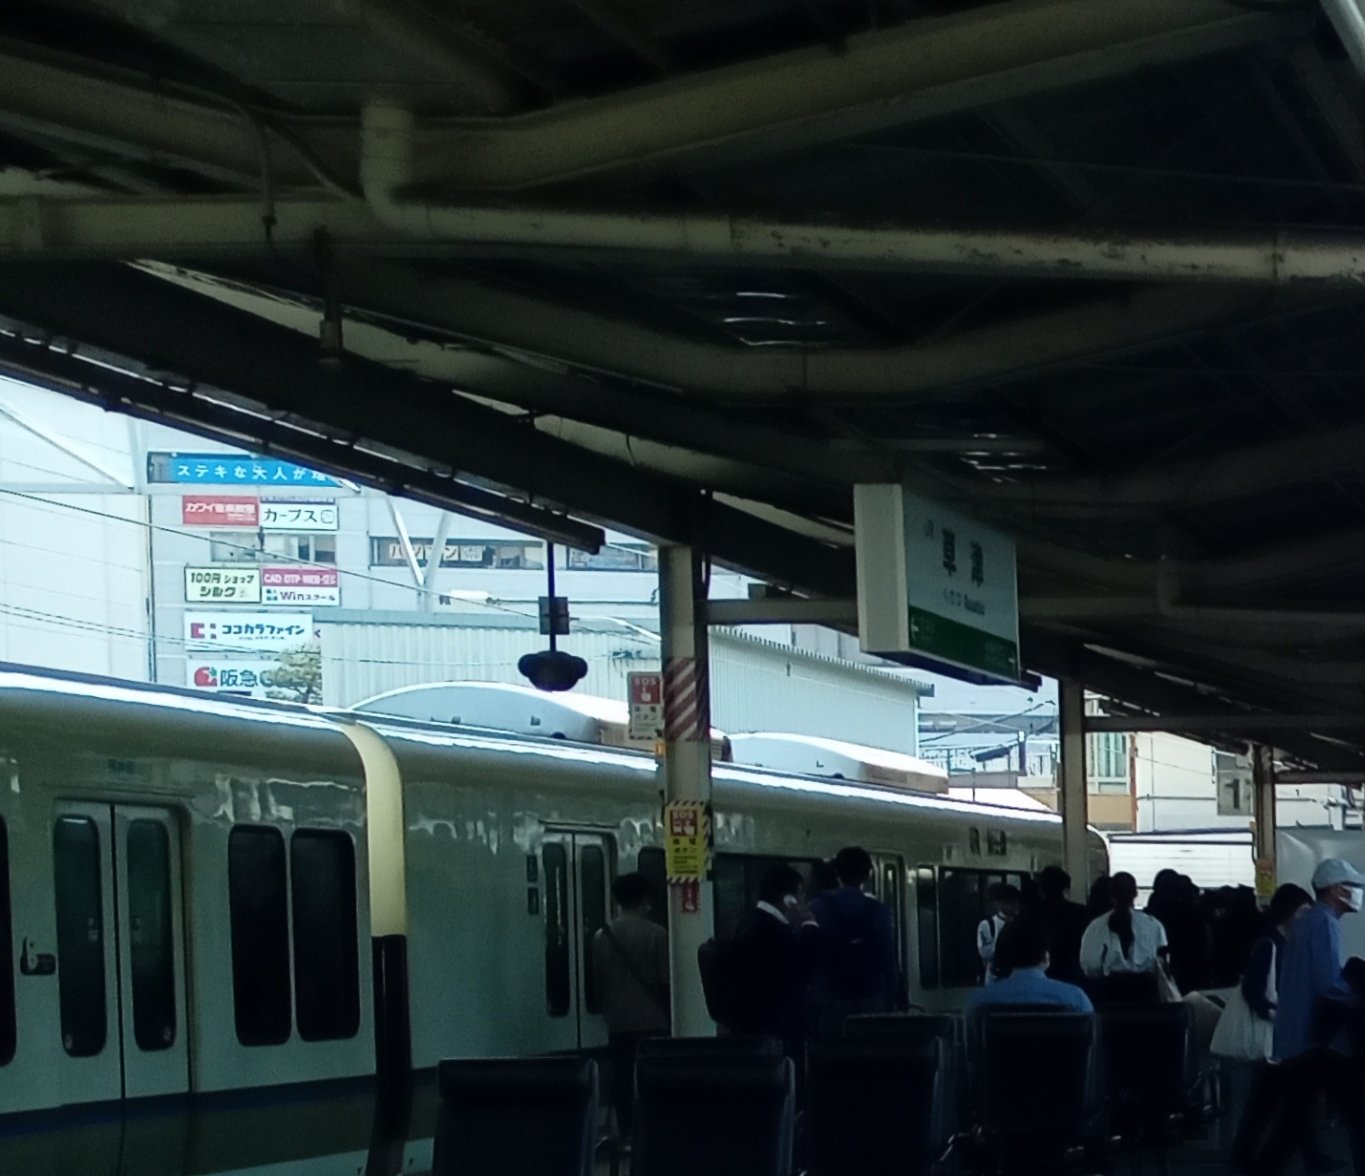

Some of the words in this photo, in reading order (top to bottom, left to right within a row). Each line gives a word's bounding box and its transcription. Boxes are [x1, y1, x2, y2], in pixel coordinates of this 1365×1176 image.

[221, 623, 305, 636] ココカラファイン
[1225, 778, 1240, 809] 1
